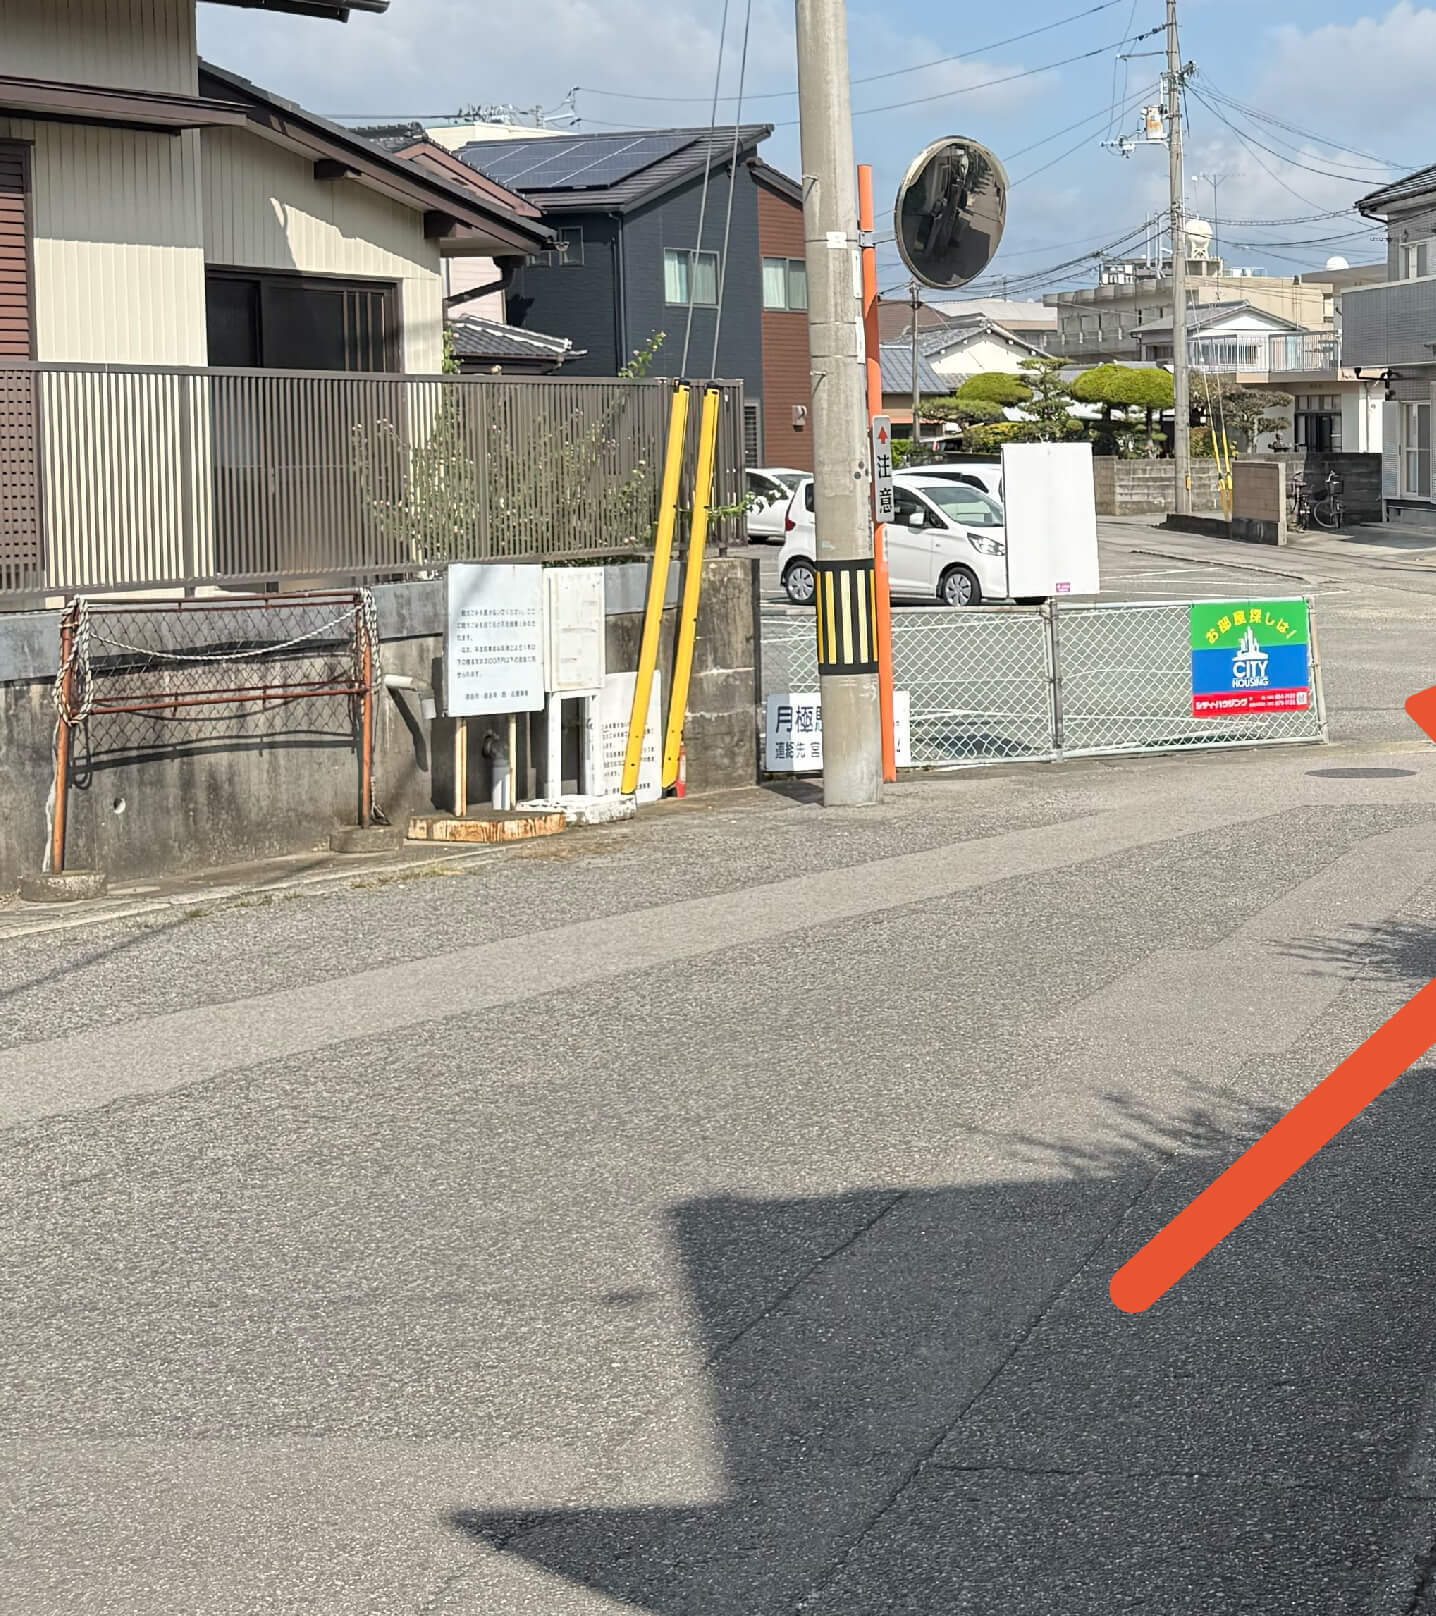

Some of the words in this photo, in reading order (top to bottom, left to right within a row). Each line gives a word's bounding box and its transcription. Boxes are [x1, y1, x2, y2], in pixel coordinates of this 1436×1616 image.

[876, 454, 891, 514] 注意
[1233, 661, 1268, 678] CITY
[1232, 678, 1269, 688] HOUSING
